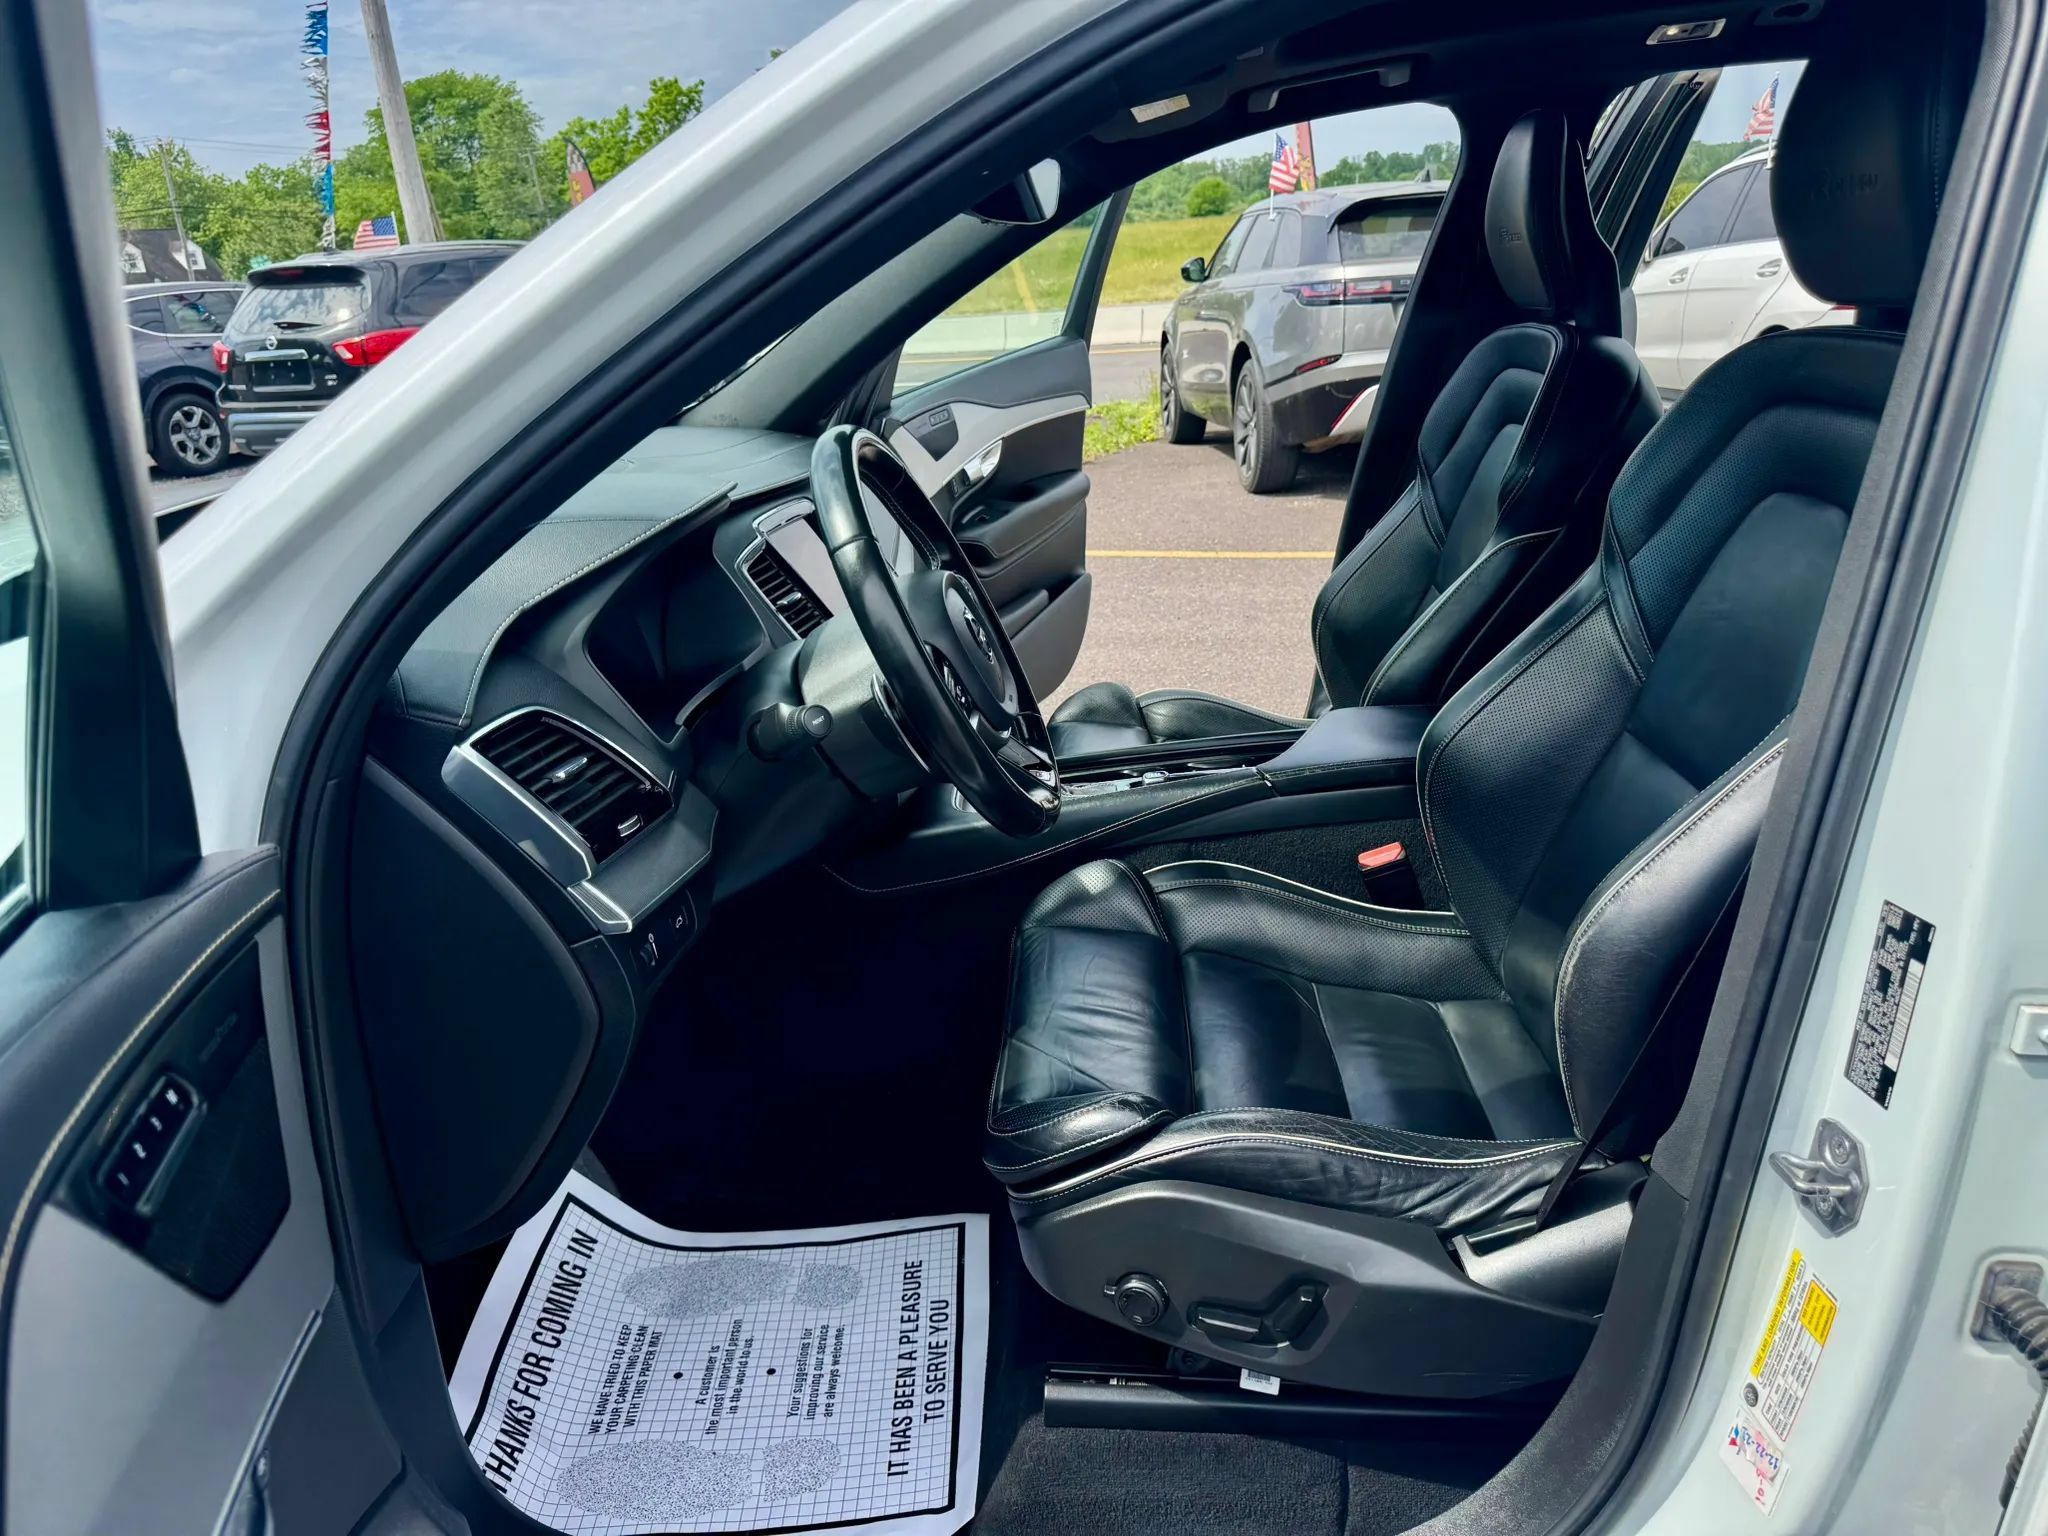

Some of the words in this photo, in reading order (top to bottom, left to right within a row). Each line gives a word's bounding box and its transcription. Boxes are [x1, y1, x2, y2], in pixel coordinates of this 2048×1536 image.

[567, 1228, 598, 1259] IN
[531, 1260, 587, 1348] COMING
[899, 1259, 922, 1345] PLEASURE
[929, 1300, 950, 1336] YOU
[617, 1324, 632, 1347] KEEP
[648, 1330, 663, 1348] MAT
[728, 1319, 743, 1347] person
[801, 1328, 813, 1340] for
[817, 1324, 829, 1355] service
[612, 1348, 625, 1361] TO
[708, 1345, 720, 1353] is
[740, 1350, 752, 1359] to
[898, 1349, 917, 1361] A
[639, 1349, 657, 1378] PAPER
[699, 1356, 718, 1396] customer
[715, 1348, 736, 1391] important
[735, 1360, 749, 1385] world
[793, 1342, 811, 1393] suggestions
[814, 1357, 825, 1372] our
[925, 1340, 949, 1394] SERVE
[513, 1352, 555, 1401] FOR
[603, 1363, 621, 1390] TRIED
[605, 1406, 623, 1434] YOUR
[614, 1354, 639, 1405] CARPETING
[631, 1325, 649, 1353] CLEAN
[825, 1369, 841, 1399] always
[893, 1367, 917, 1410] BEEN
[632, 1379, 648, 1400] THIS
[729, 1387, 743, 1403] the
[804, 1373, 824, 1420] improving
[594, 1391, 612, 1416] HAVE
[623, 1402, 641, 1428] WITH
[712, 1394, 725, 1417] most
[726, 1405, 739, 1414] in
[787, 1396, 800, 1417] Your
[824, 1403, 835, 1417] are
[924, 1399, 945, 1424] TO
[588, 1418, 603, 1435] WE
[705, 1420, 719, 1435] the
[889, 1416, 913, 1453] HAS
[887, 1460, 909, 1477] IT
